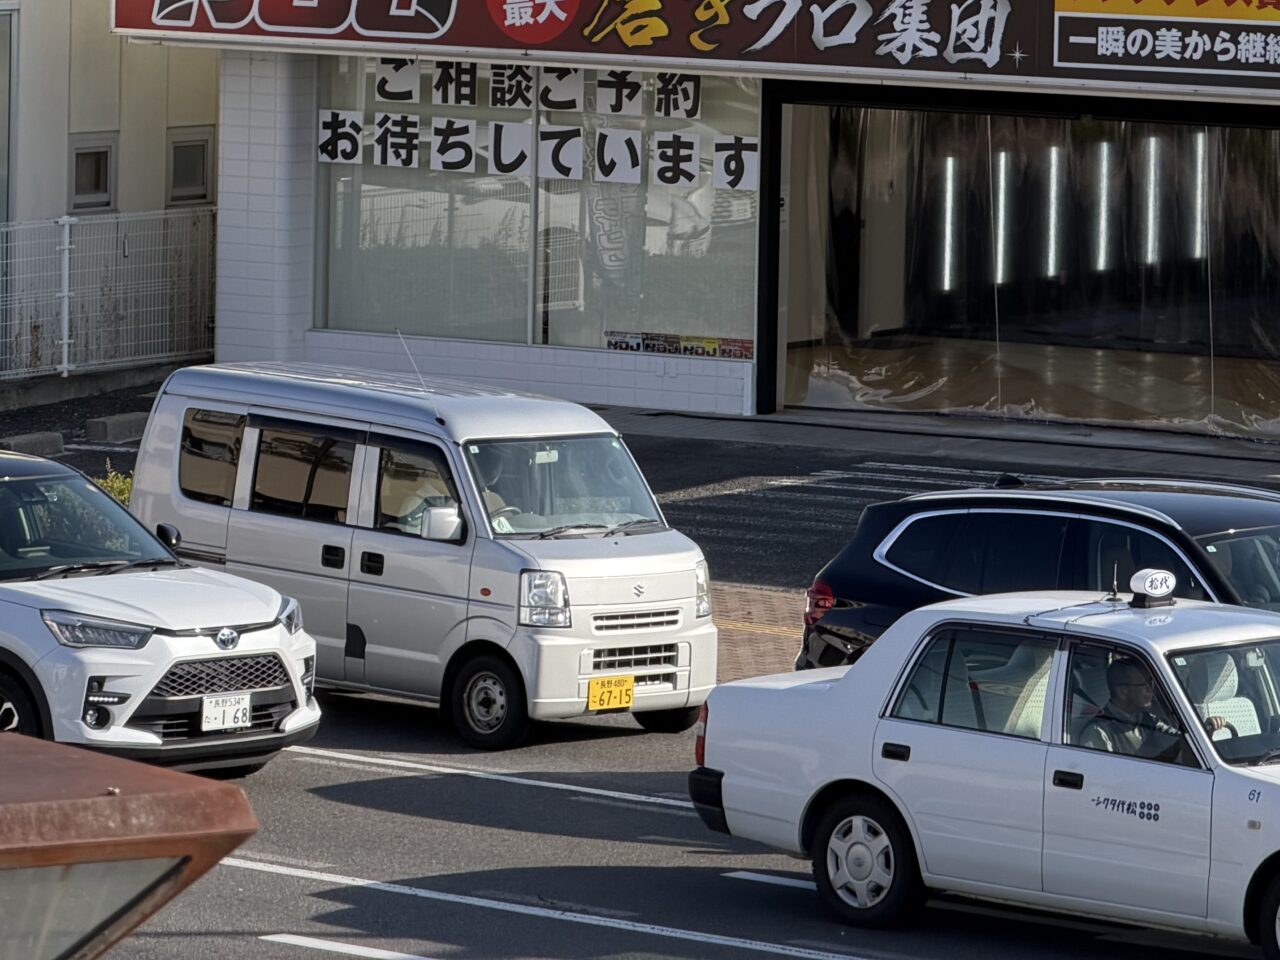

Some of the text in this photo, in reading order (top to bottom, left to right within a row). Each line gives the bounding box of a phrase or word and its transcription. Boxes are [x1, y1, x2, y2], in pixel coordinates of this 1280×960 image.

[375, 58, 701, 119] ご相談ご予約
[318, 111, 758, 189] お待ちしています
[1248, 789, 1261, 803] 61
